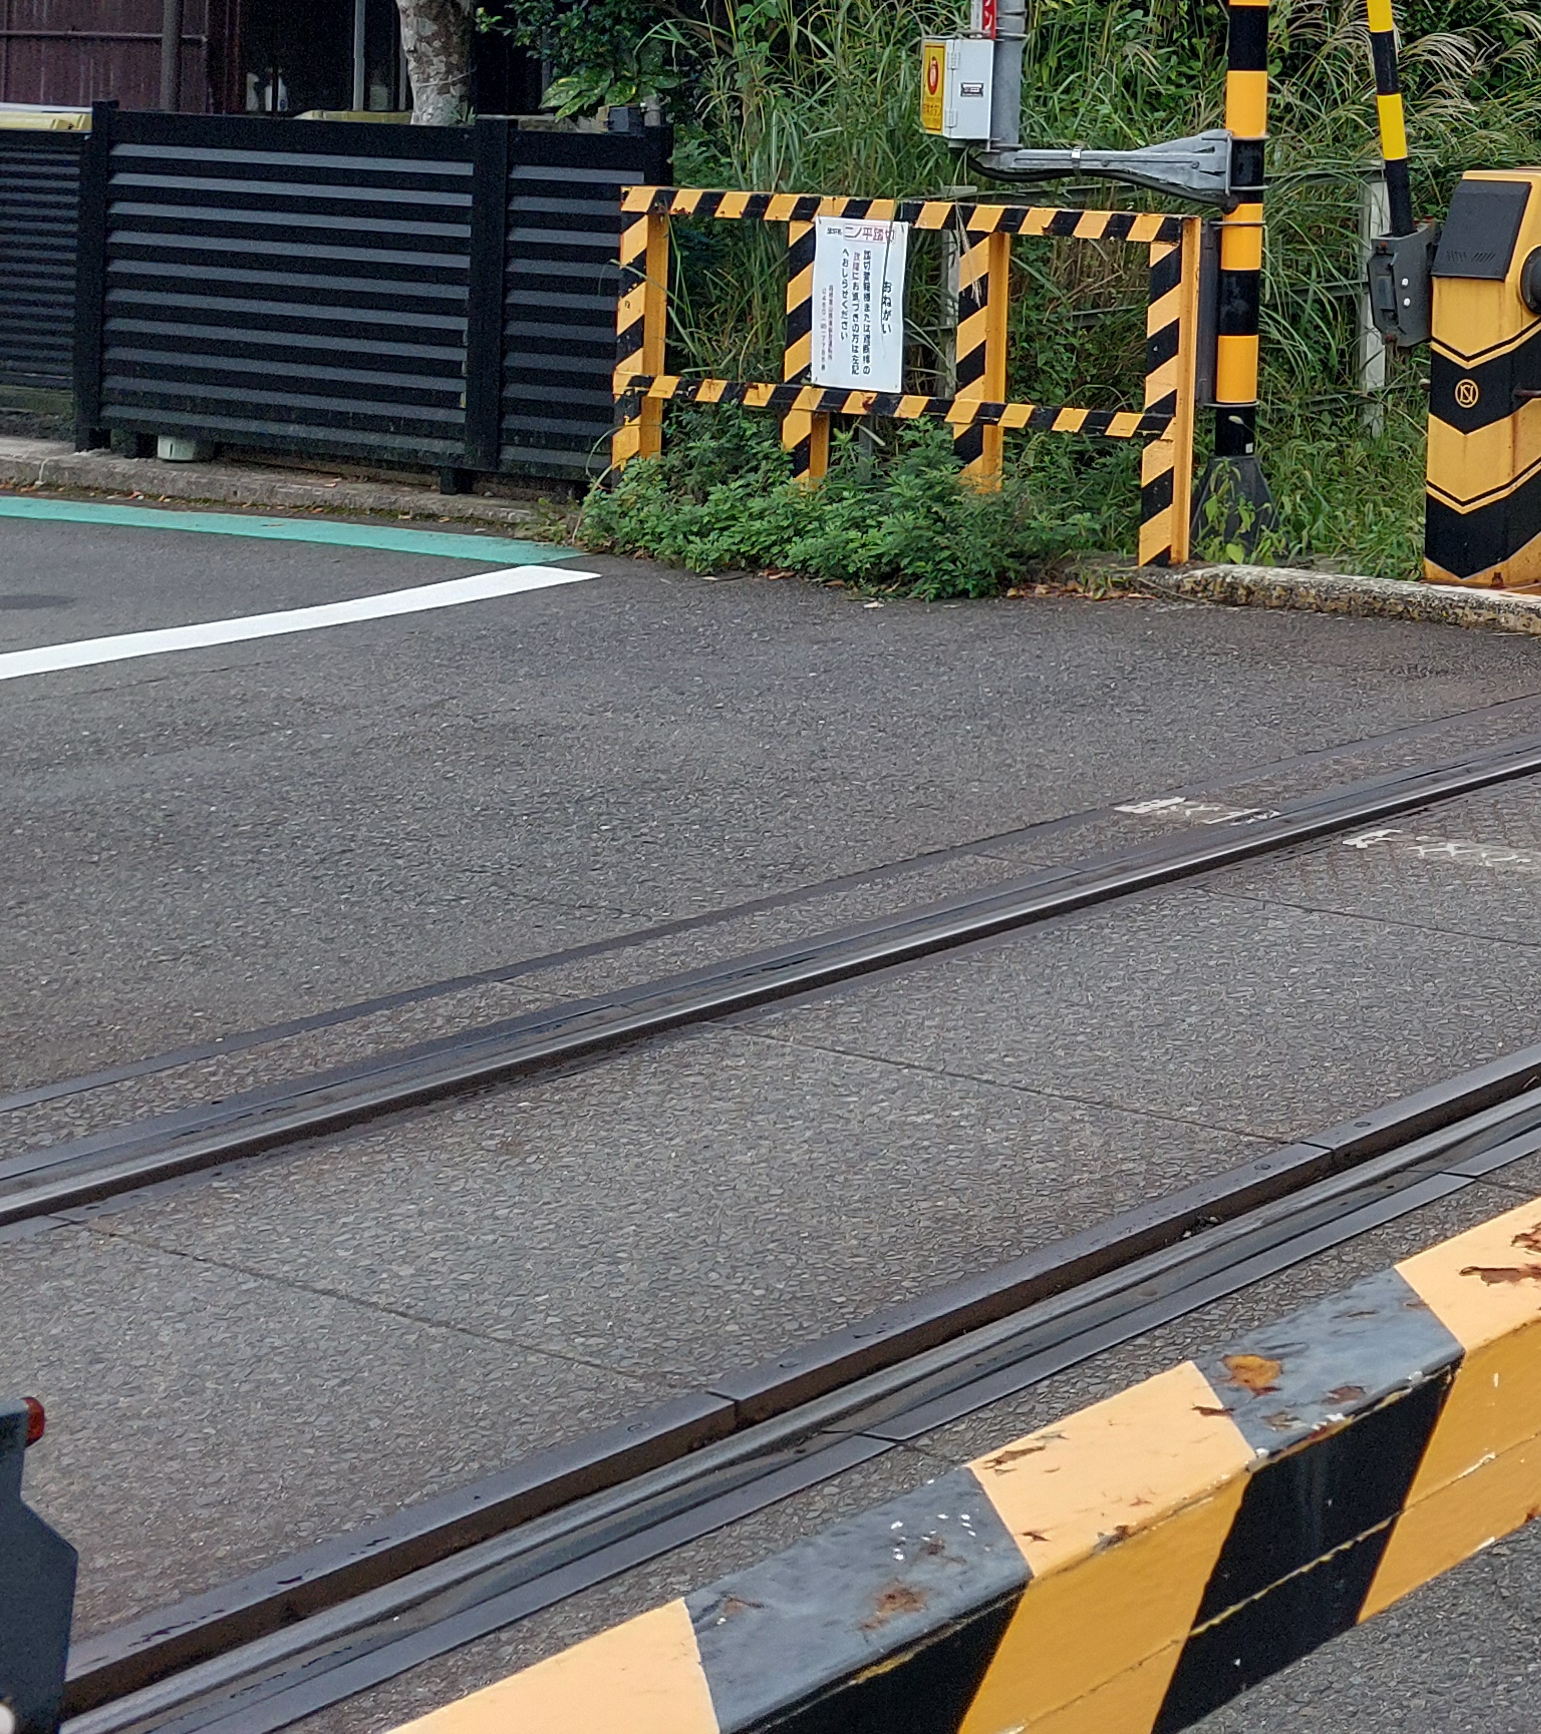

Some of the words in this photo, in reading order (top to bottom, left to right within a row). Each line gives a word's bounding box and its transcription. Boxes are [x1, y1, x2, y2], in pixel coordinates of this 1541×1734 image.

[840, 248, 850, 341] へおしらせください
[881, 281, 892, 334] おねがい
